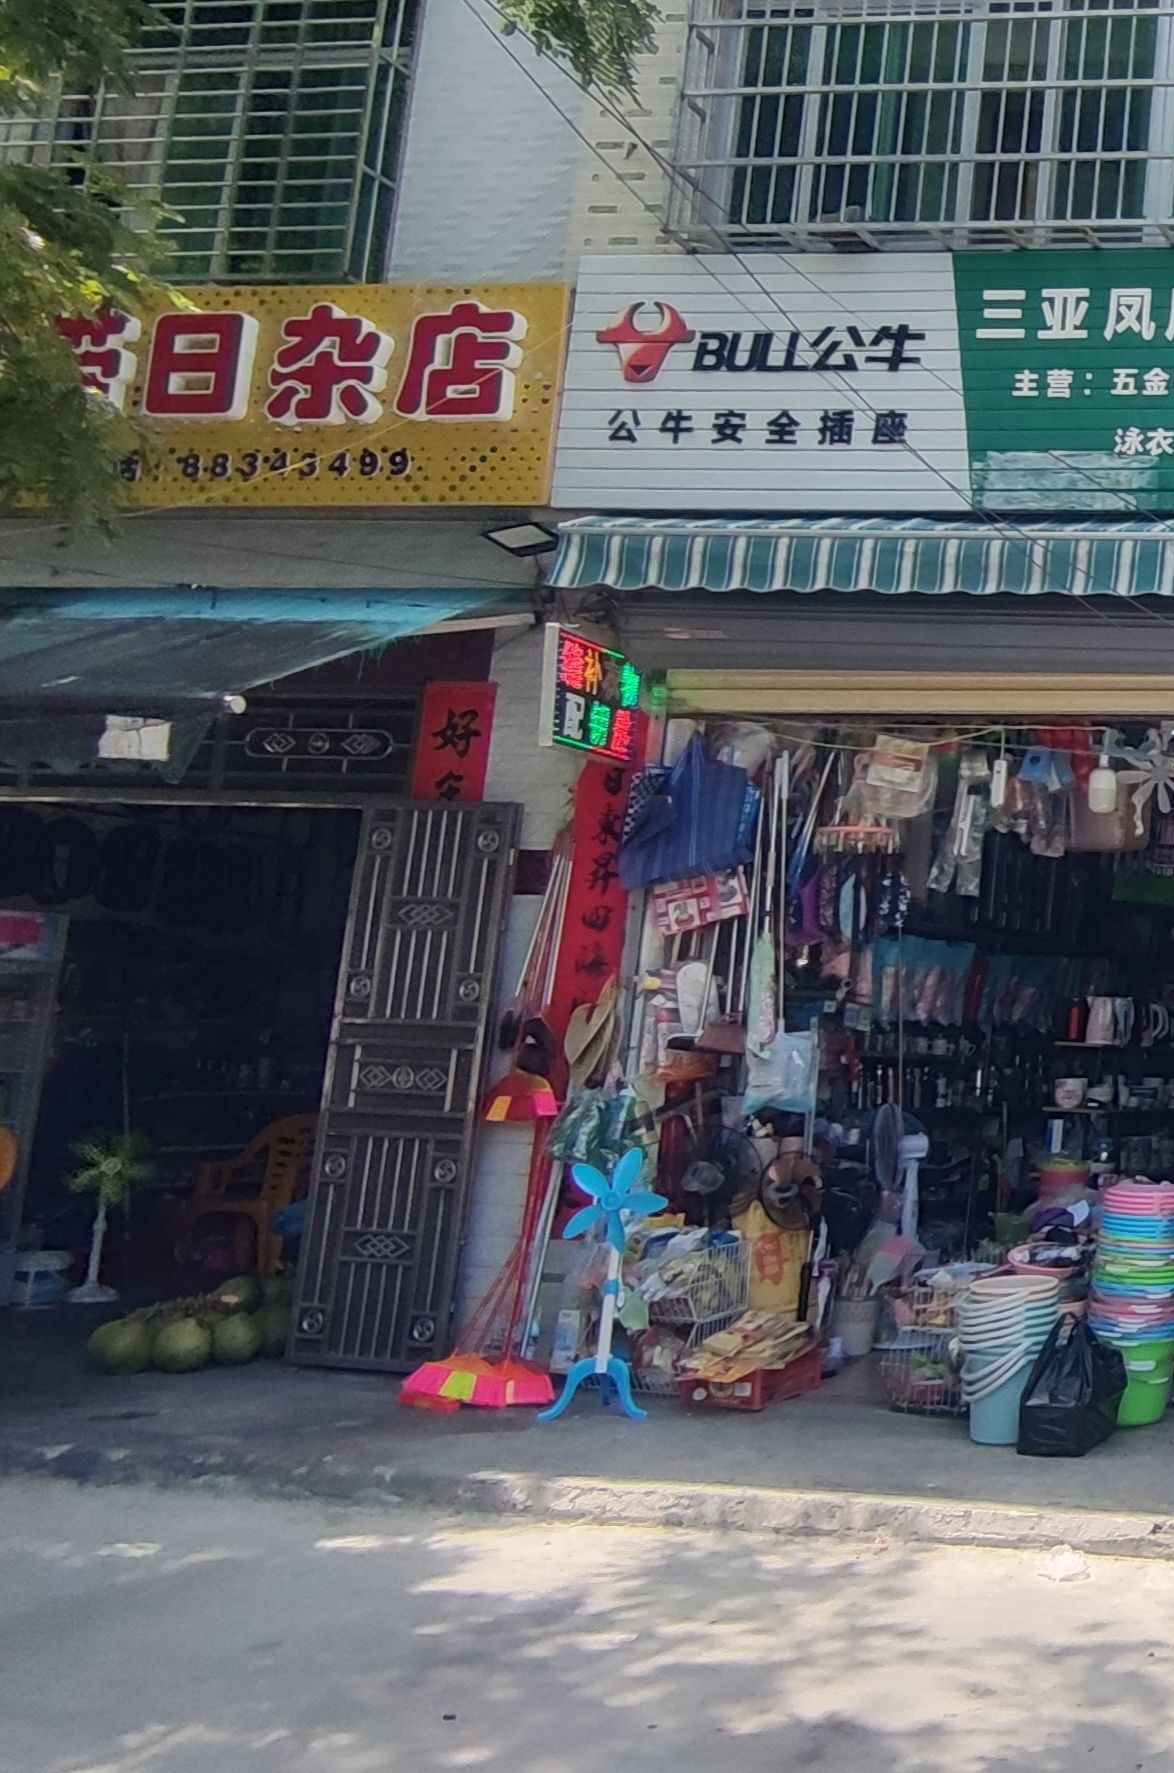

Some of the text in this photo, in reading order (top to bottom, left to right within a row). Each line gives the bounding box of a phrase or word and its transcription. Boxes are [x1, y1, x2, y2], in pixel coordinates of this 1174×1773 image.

[607, 408, 909, 446] 公牛安全插座
